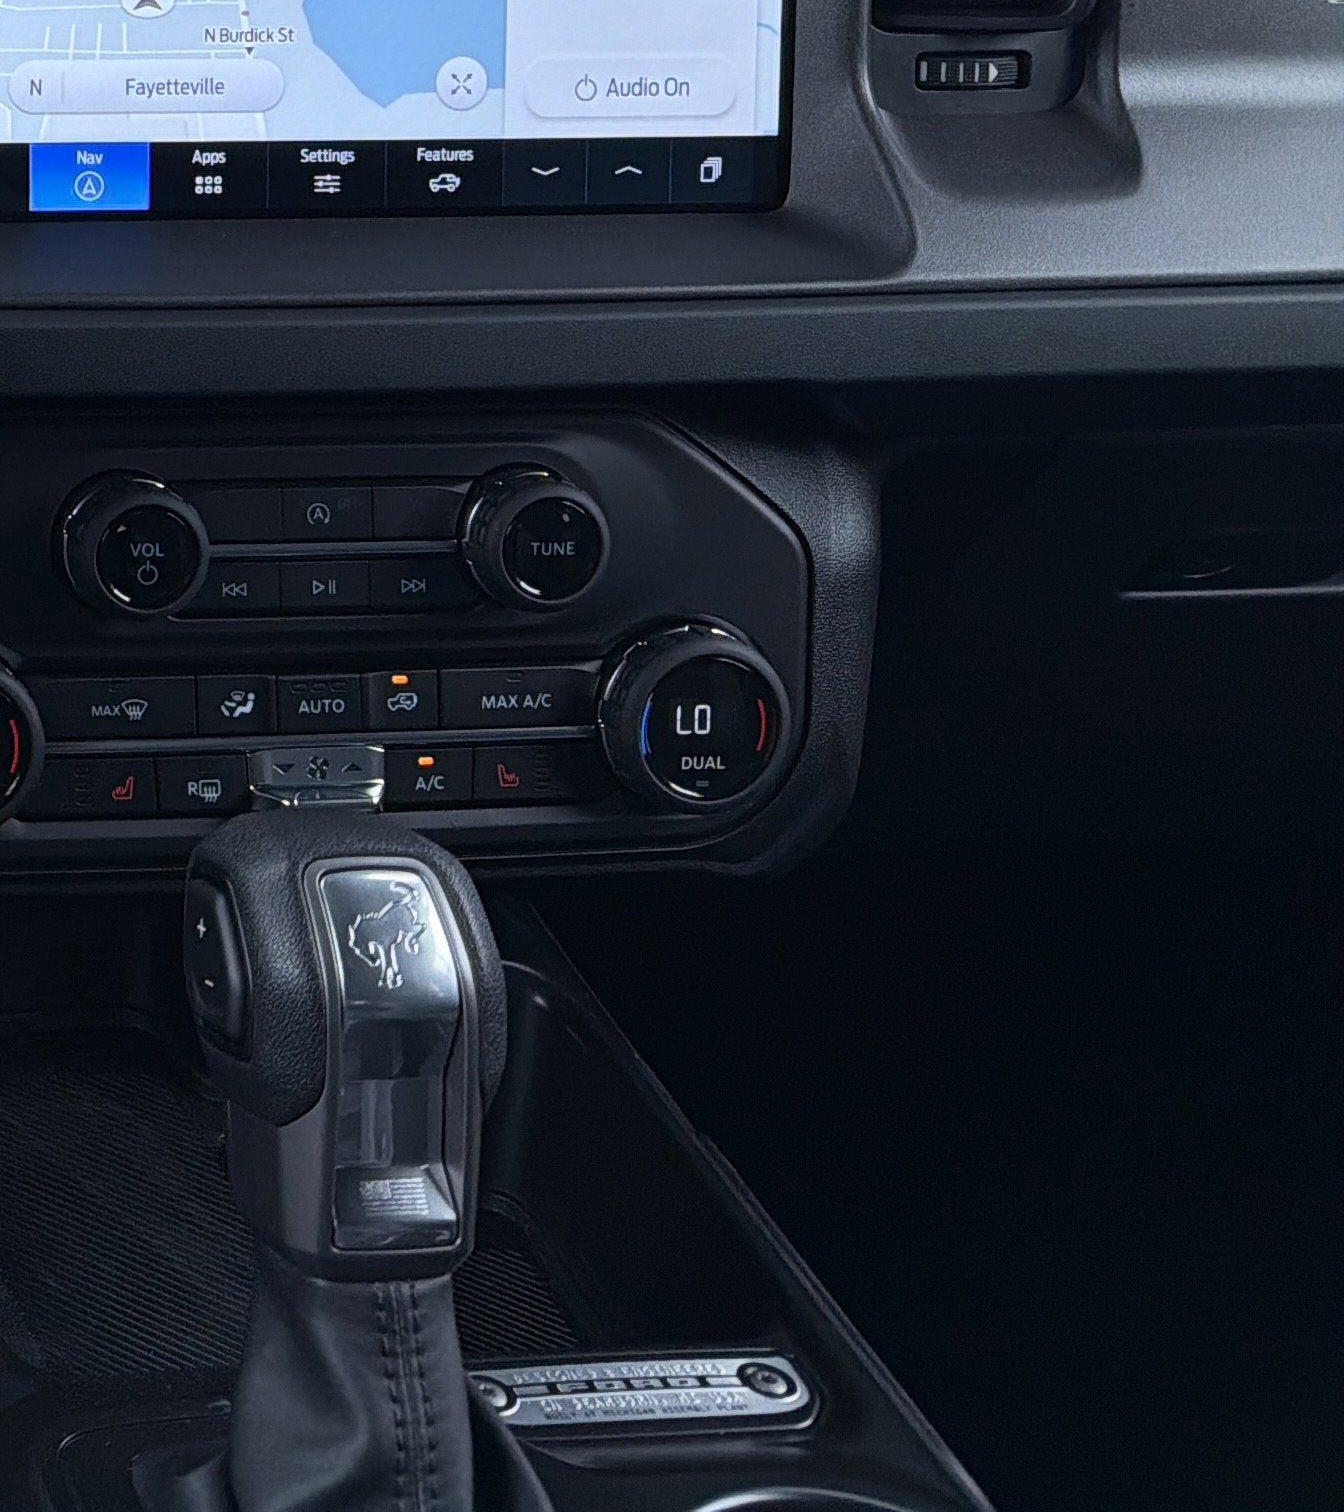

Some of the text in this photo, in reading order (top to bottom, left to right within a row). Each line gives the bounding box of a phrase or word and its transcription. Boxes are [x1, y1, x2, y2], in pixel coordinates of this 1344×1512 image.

[204, 27, 294, 44] N Burdick St
[30, 80, 42, 96] N
[125, 78, 226, 100] Fayetteville
[606, 78, 690, 98] Audio On
[77, 150, 103, 165] Nav
[192, 150, 226, 169] Apps
[300, 149, 355, 166] Settings
[416, 148, 474, 163] Features
[129, 542, 165, 559] VOL
[530, 541, 576, 558] TUNE
[298, 699, 345, 714] AUTO
[481, 693, 552, 709] MAX A/C
[90, 706, 121, 718] MAX
[674, 704, 712, 737] LO
[680, 756, 726, 771] DUAL
[187, 782, 198, 796] R
[415, 775, 445, 791] A/C
